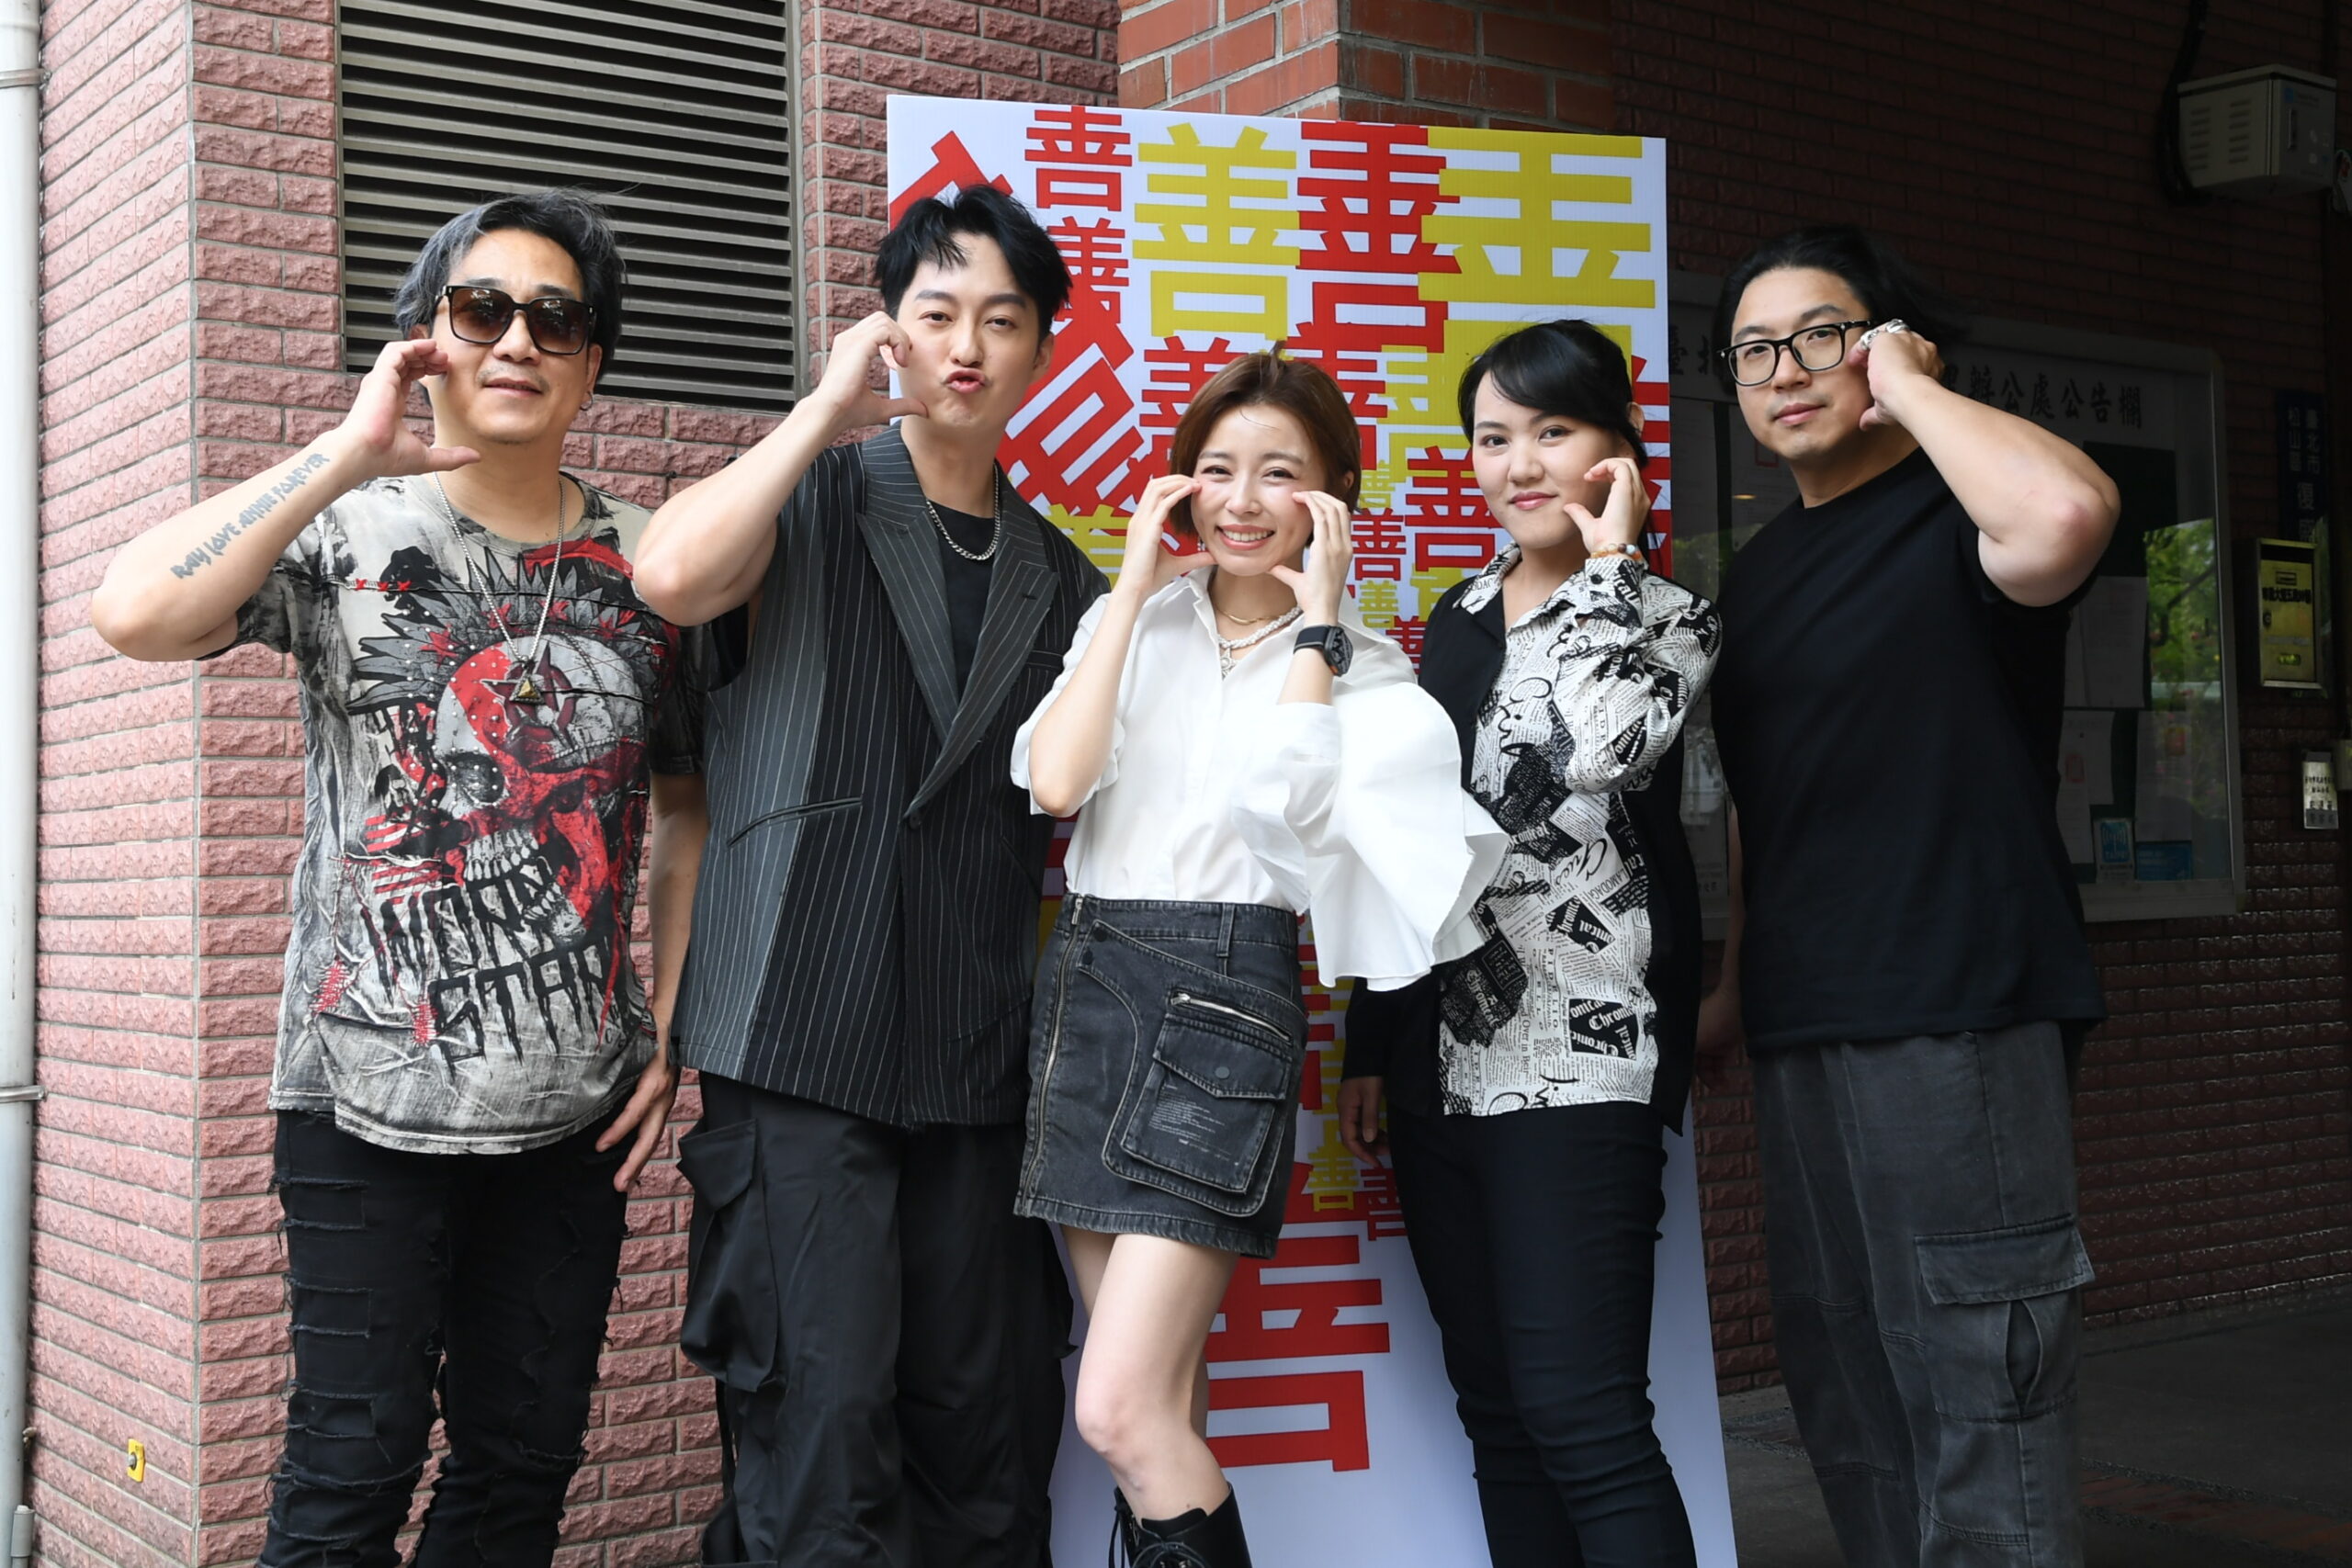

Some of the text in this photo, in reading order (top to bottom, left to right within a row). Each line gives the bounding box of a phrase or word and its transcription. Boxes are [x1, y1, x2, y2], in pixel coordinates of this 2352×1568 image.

[1024, 105, 1132, 212] 善
[1133, 123, 1301, 338] 善
[1351, 507, 1407, 581] 善
[1405, 445, 1507, 572] 善
[1358, 580, 1398, 629] 善
